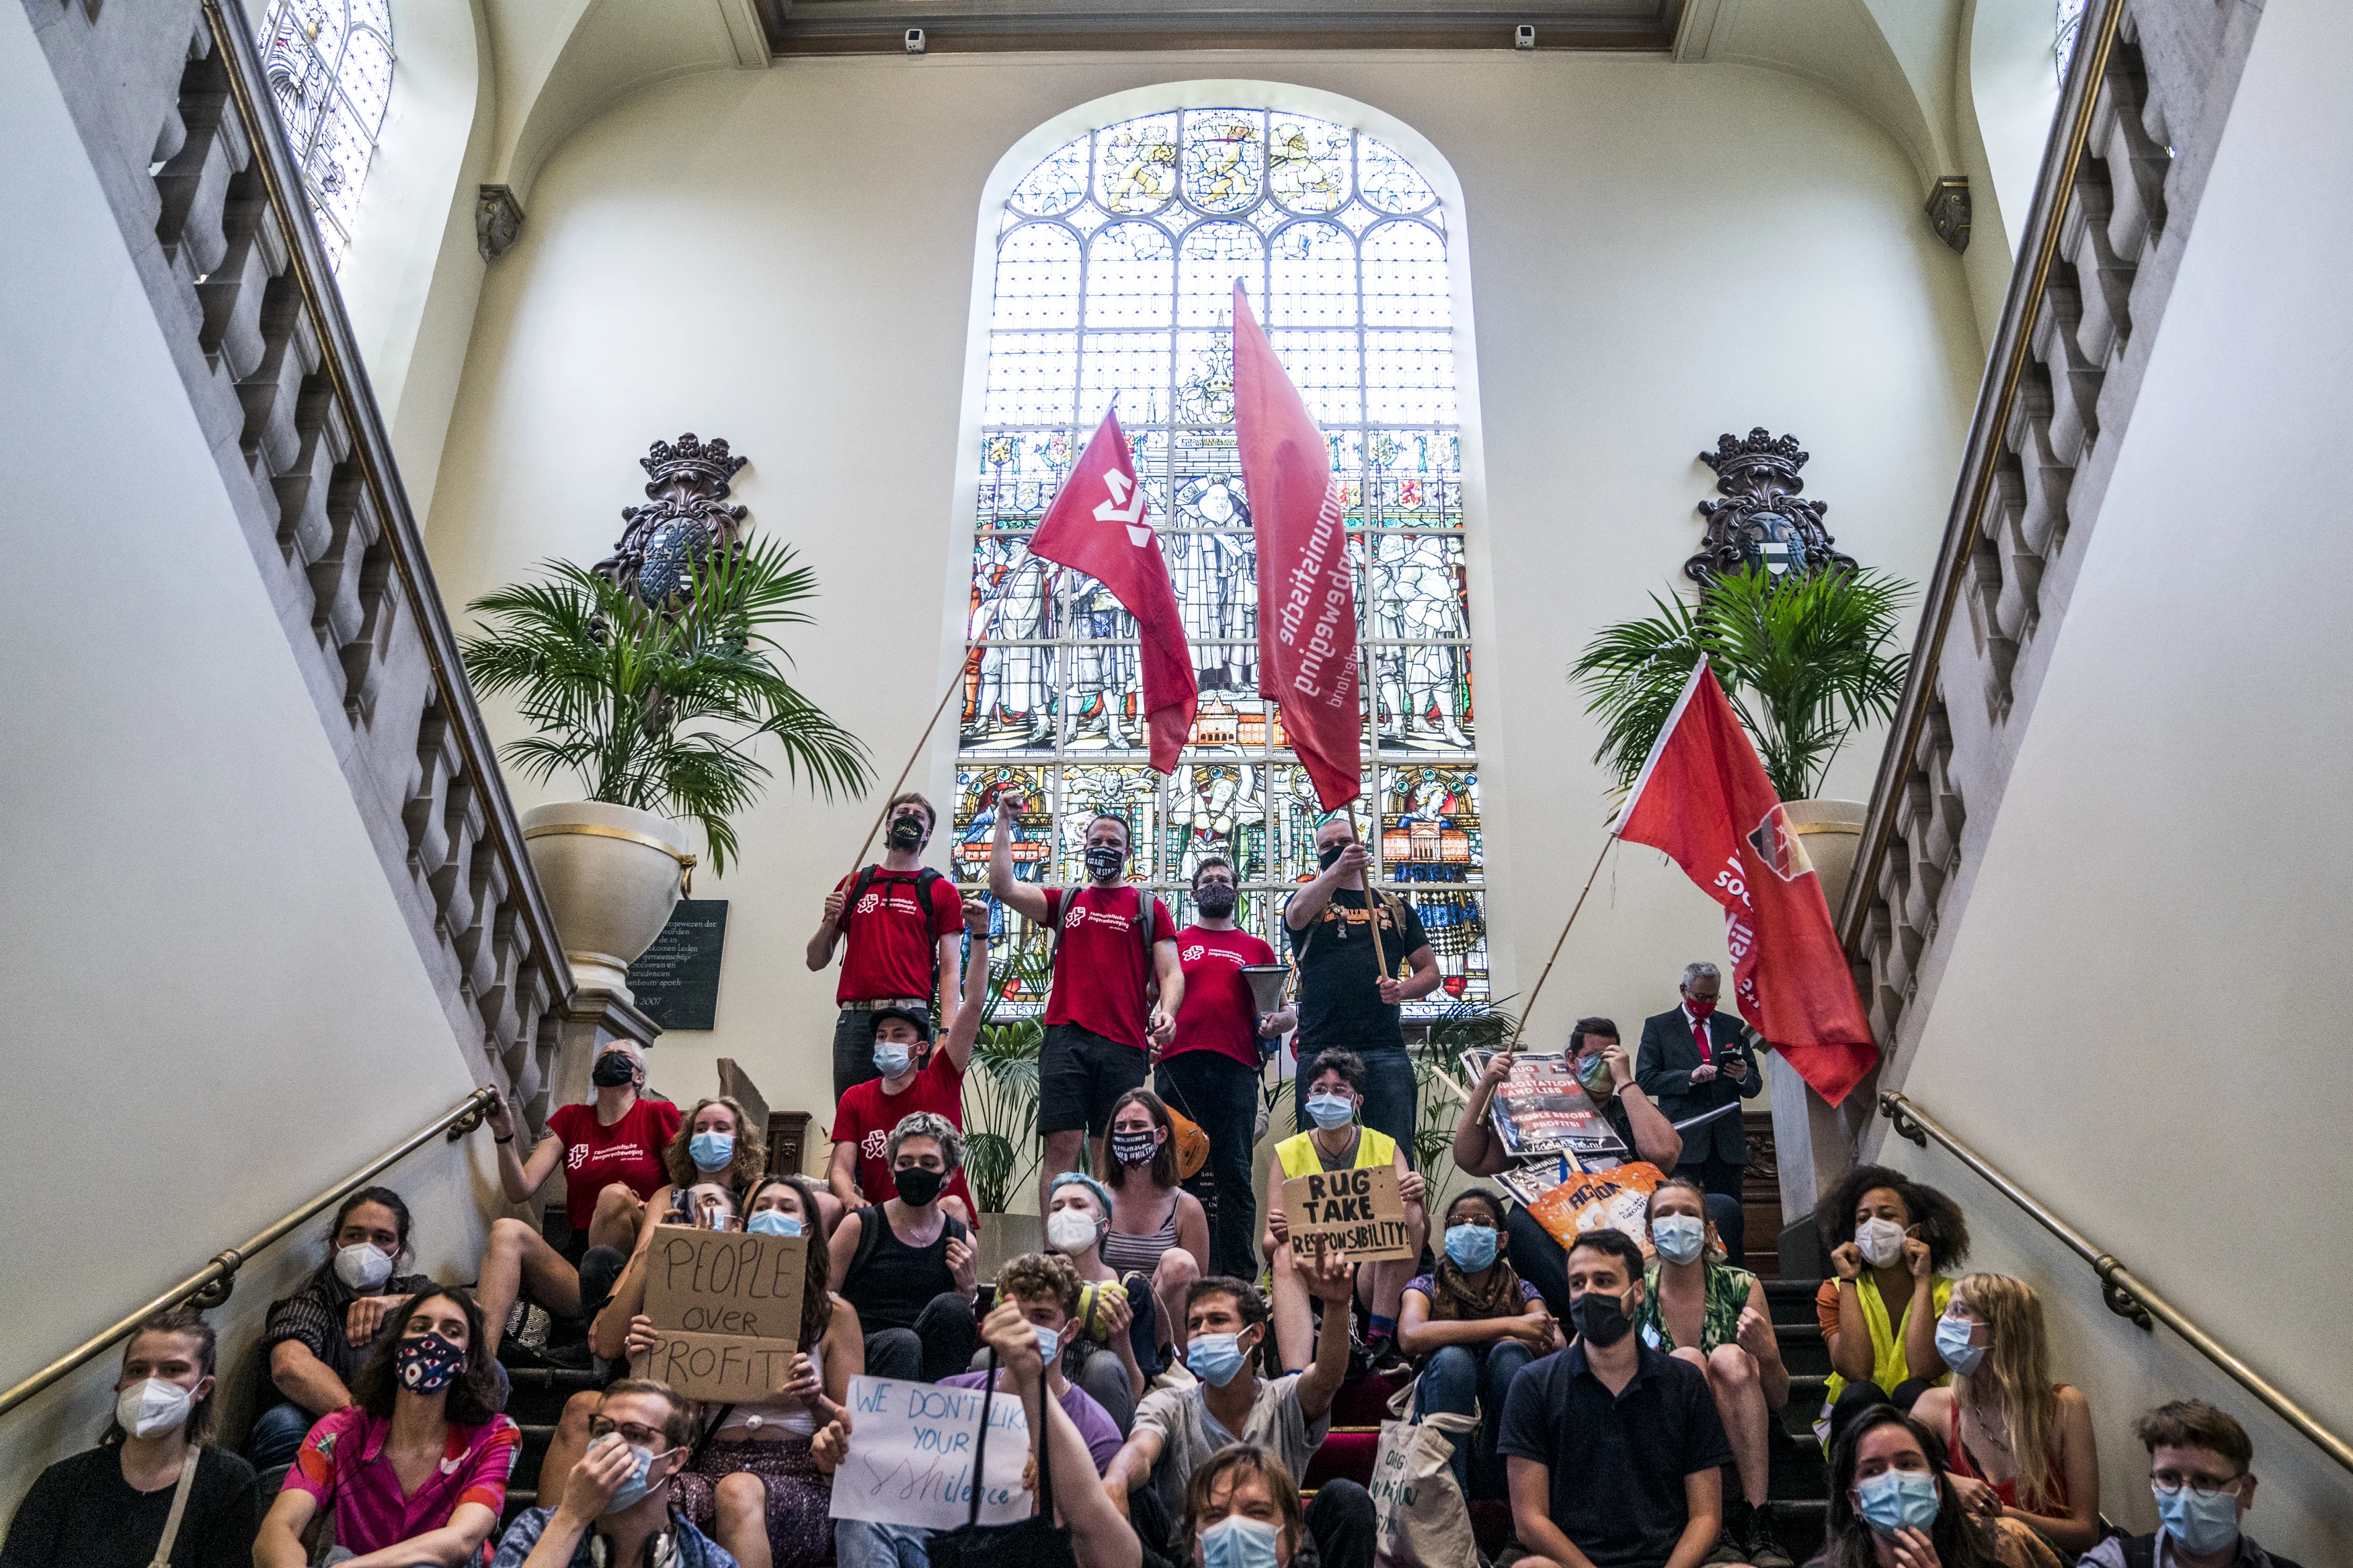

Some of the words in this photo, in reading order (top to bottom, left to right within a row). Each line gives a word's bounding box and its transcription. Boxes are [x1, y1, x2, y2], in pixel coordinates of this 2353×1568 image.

[1088, 915, 1129, 929] jongerenbeweging
[1090, 911, 1125, 921] communistische
[1207, 952, 1246, 965] jongerenbeweging
[1209, 948, 1242, 958] communistische
[640, 997, 662, 1005] 2007
[1508, 1087, 1533, 1096] AND
[1511, 1112, 1551, 1122] PEOPLE
[1533, 1120, 1580, 1128] PROFITS!
[592, 1149, 643, 1161] jongerenbeweging
[594, 1143, 637, 1155] communistische
[1302, 1196, 1375, 1224] TAKE
[664, 1237, 796, 1298] PEOPLE
[856, 1380, 892, 1413] WE
[908, 1389, 983, 1421] DON'T
[913, 1425, 970, 1455] YOUR
